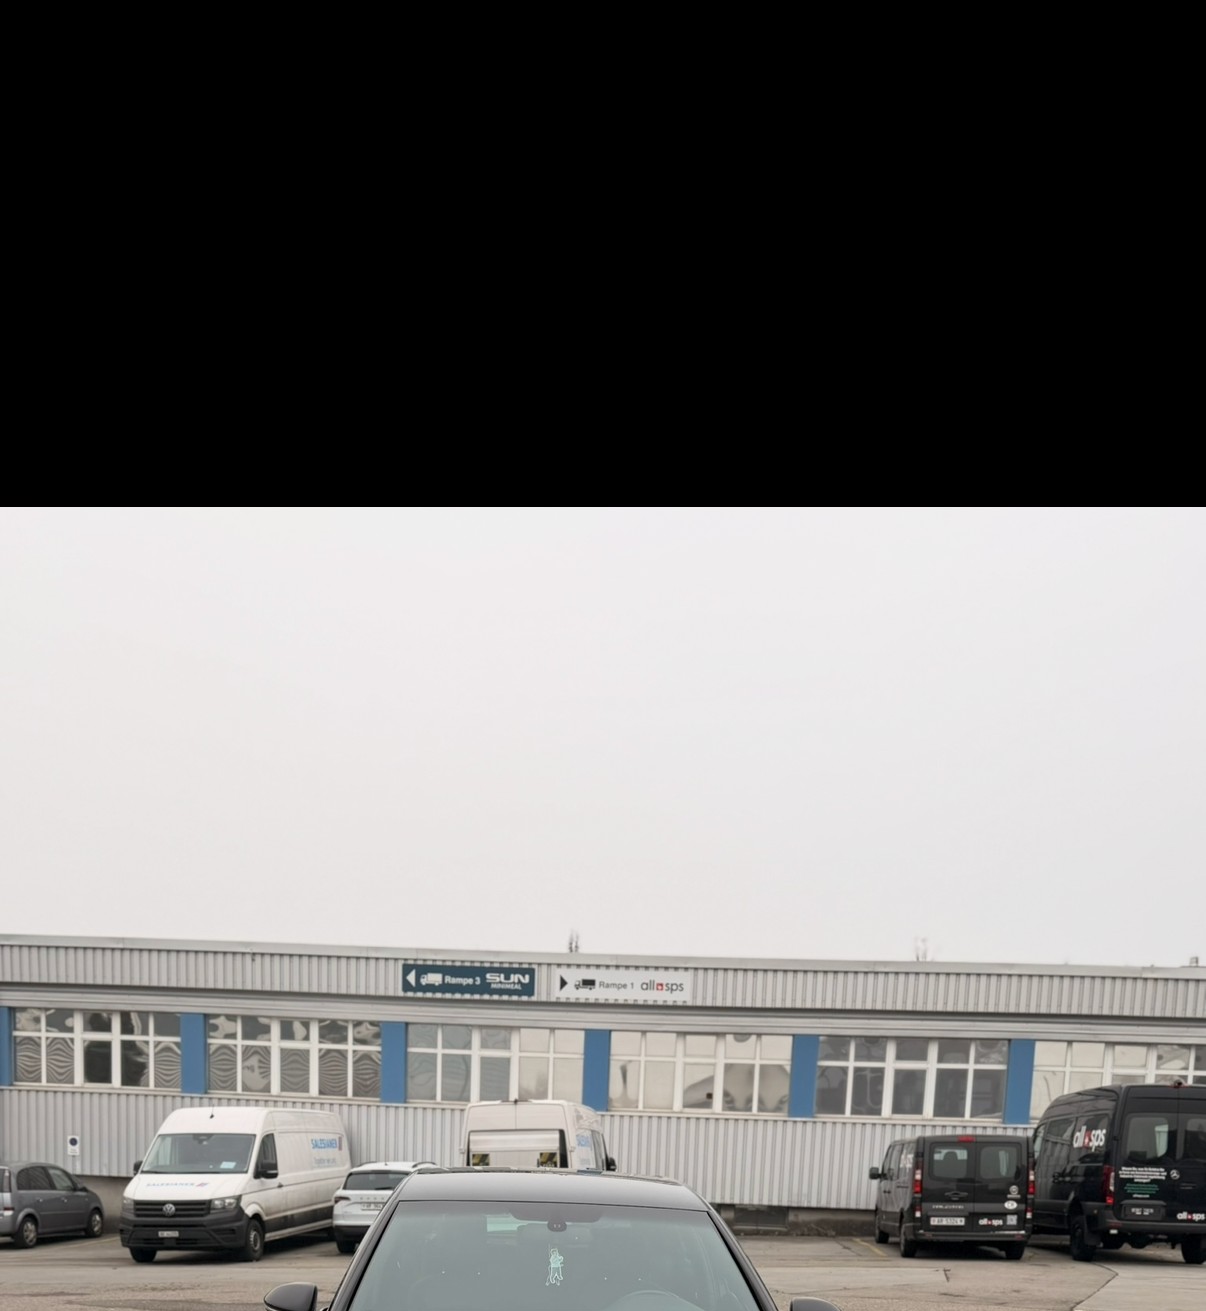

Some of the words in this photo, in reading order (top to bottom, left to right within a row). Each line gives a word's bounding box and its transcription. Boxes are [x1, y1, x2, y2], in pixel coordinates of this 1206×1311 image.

[444, 975, 473, 986] Rampe
[475, 976, 481, 985] 3
[485, 973, 530, 984] SUN
[599, 981, 627, 991] Rampe
